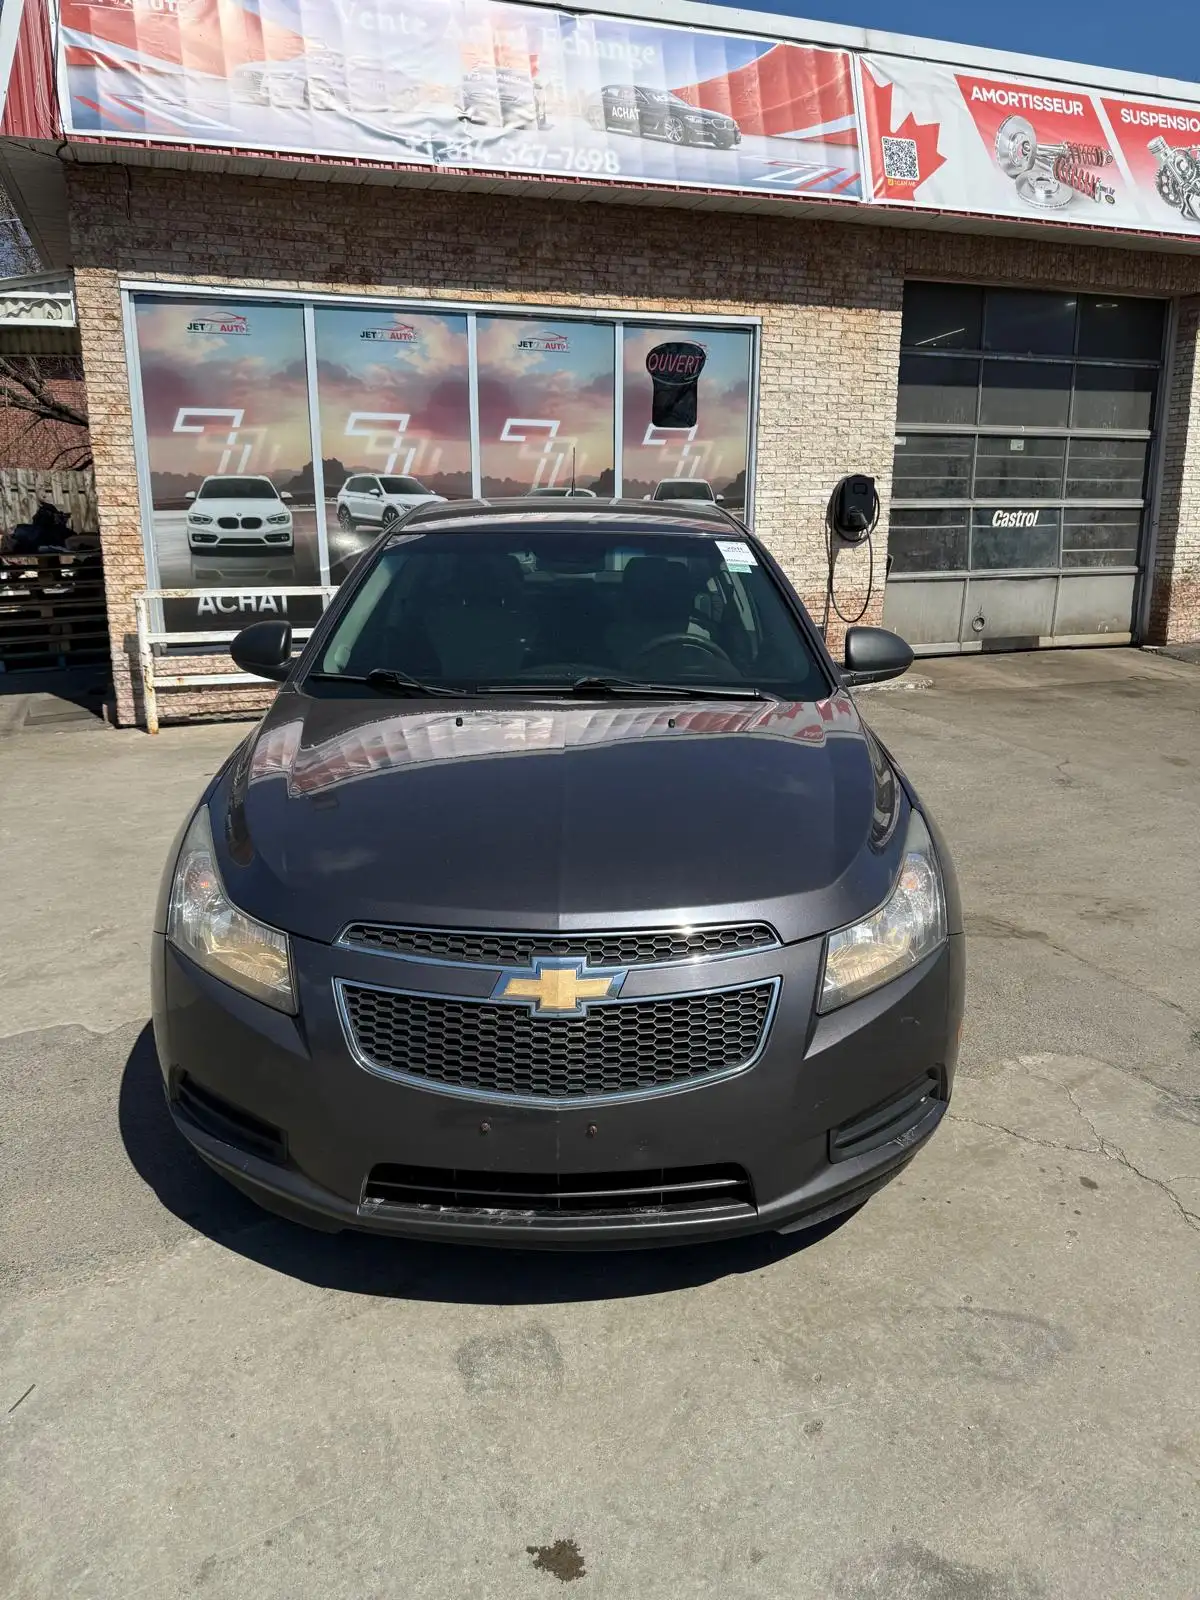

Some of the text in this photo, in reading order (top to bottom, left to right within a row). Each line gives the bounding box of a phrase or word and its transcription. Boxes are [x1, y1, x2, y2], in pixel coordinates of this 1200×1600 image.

[971, 86, 1085, 116] AMORTISSEUR
[612, 105, 641, 120] ACHAT
[1120, 108, 1200, 133] SUSPENSIO
[187, 322, 205, 331] JET
[360, 331, 376, 339] JET
[518, 340, 533, 348] JET
[648, 352, 703, 374] OUVERT
[991, 509, 1040, 528] Castrol
